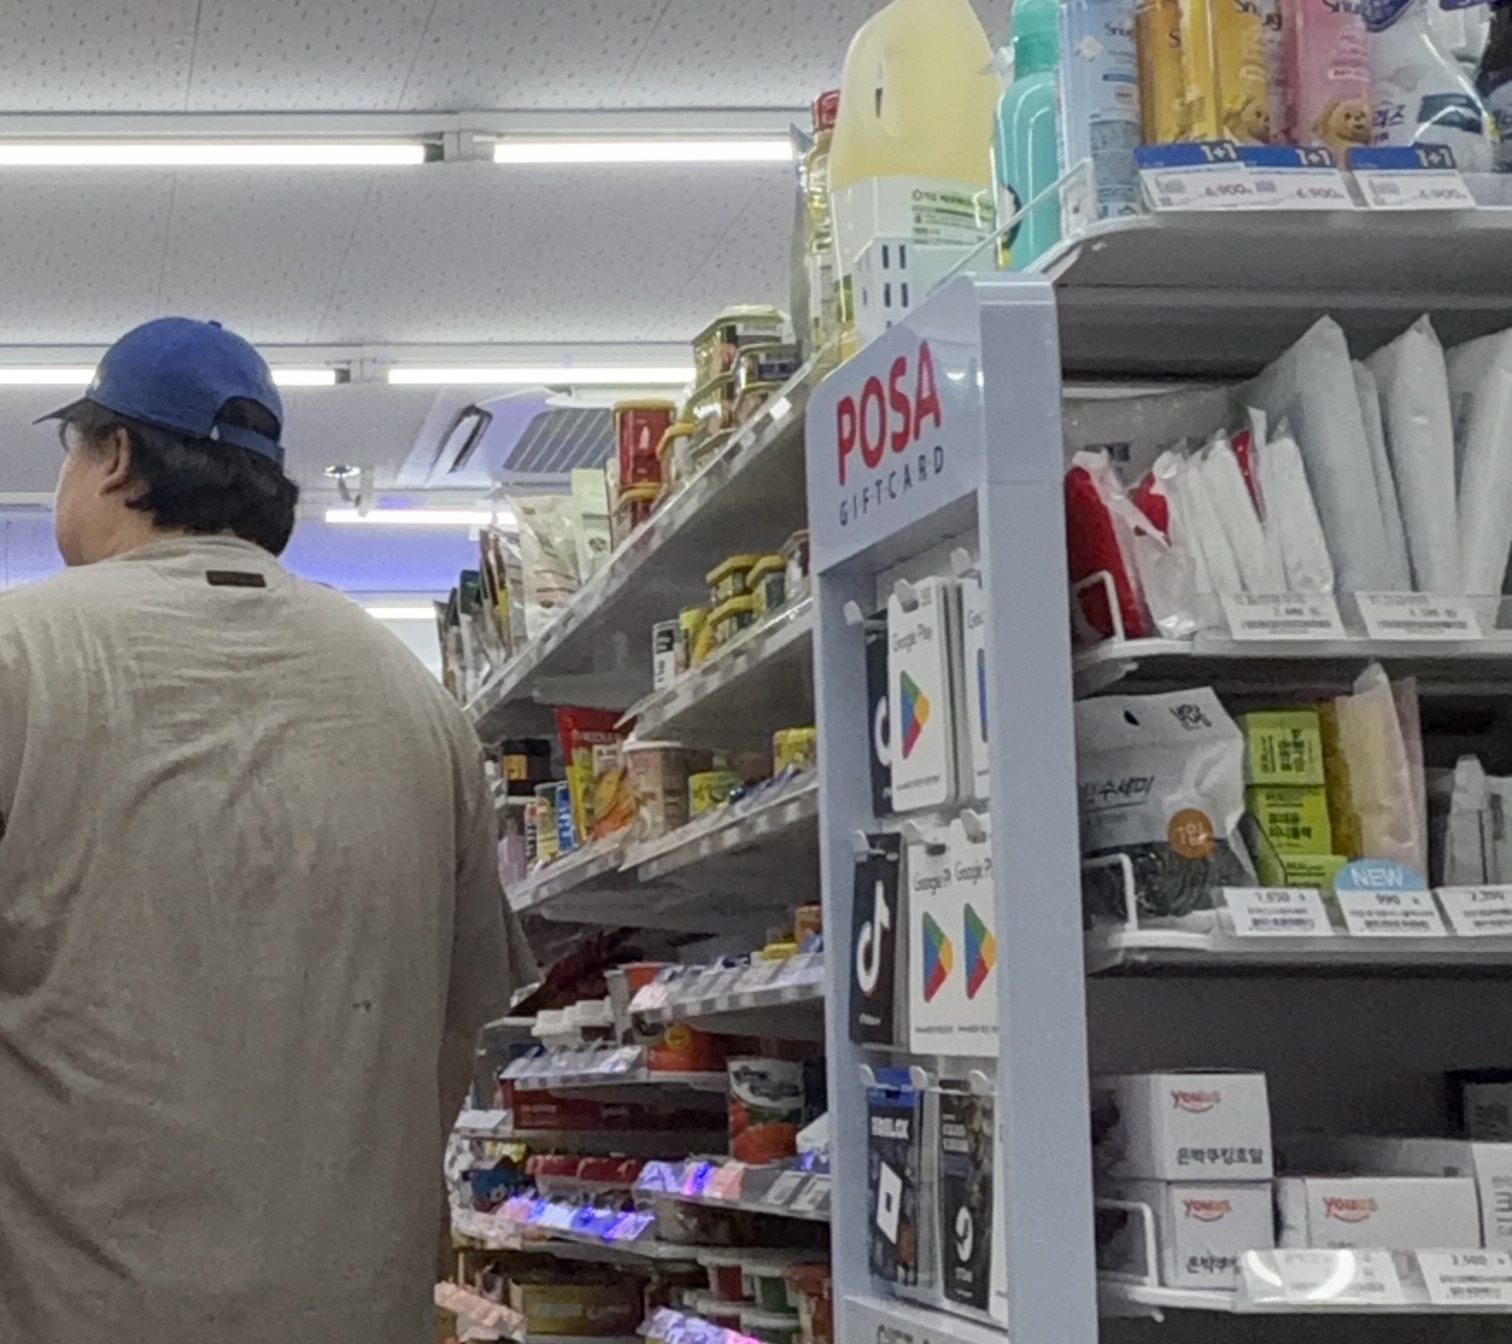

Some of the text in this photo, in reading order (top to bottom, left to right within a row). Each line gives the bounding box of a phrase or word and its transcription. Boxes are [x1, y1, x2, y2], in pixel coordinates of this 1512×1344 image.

[1200, 142, 1238, 161] 1+1
[1296, 148, 1333, 166] 1+1
[1416, 148, 1453, 168] 1+1
[837, 338, 942, 486] POSA
[839, 445, 945, 527] GIFTCARD
[1350, 868, 1405, 887] NEW
